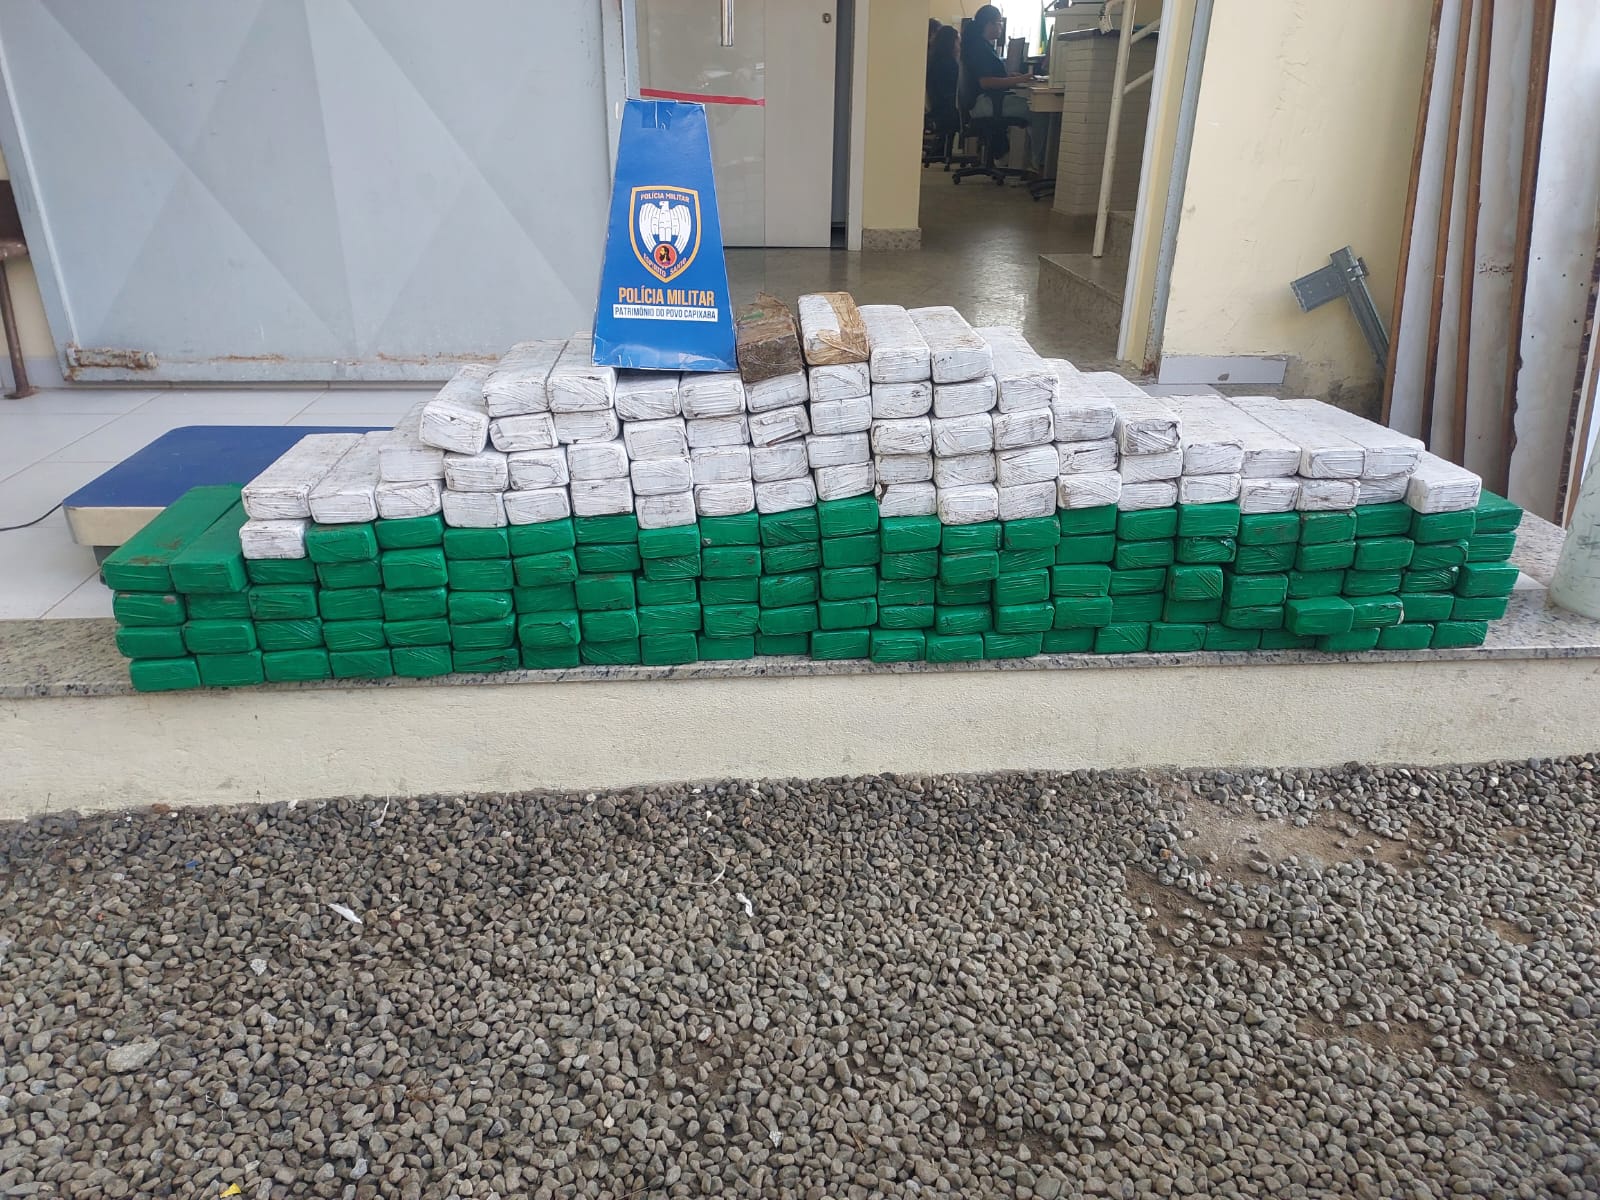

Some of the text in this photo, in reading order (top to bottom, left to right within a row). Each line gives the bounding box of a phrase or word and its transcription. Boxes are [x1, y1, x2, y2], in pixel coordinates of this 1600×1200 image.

[640, 191, 690, 203] POLÍCIA MILITAR
[618, 285, 715, 306] POLÍCIA MILITAR
[615, 306, 716, 319] PATRIMÔNIO DO POVO CAPIXABA
